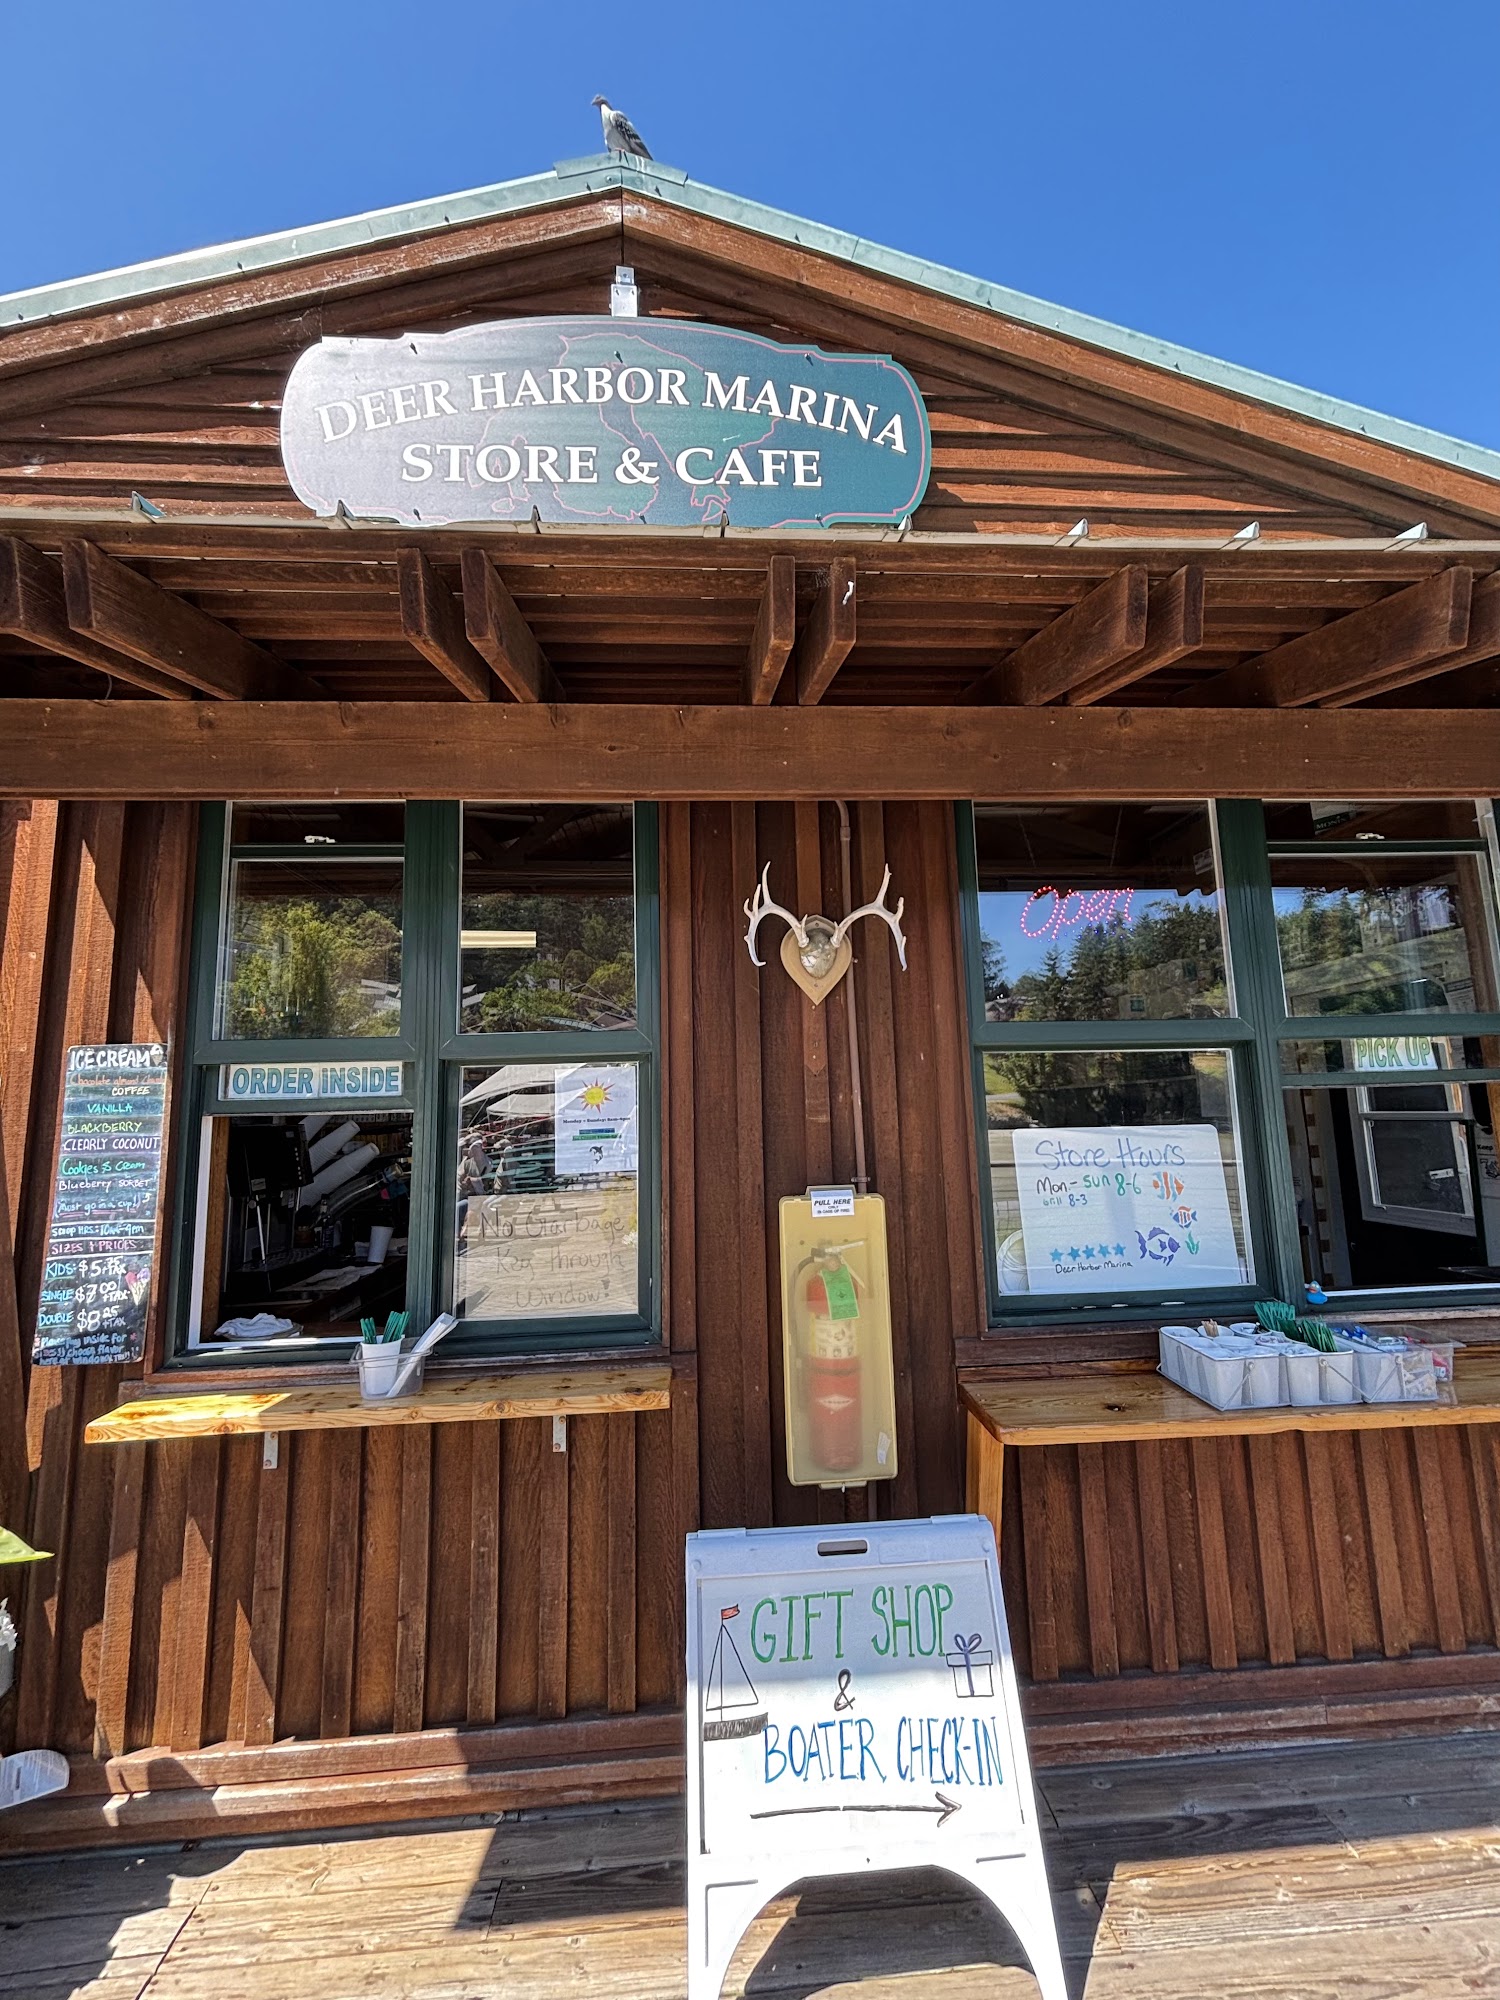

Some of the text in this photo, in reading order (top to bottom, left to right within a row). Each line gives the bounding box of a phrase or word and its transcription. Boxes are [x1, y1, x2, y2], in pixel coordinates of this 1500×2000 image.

[314, 366, 908, 454] DEER HARBOR MARINA
[401, 444, 822, 487] STORE & CAFE
[69, 1048, 150, 1070] ICE CREAM
[1356, 1036, 1431, 1067] PICK UP
[232, 1067, 314, 1094] ORDER
[112, 1086, 151, 1096] COFFEE
[87, 1103, 133, 1113] VANILLA
[67, 1121, 142, 1134] BLACKBERRY
[63, 1137, 161, 1151] CLEARLY COCONUT
[1035, 1138, 1186, 1170] Store Hours
[62, 1158, 98, 1178] Cookies
[59, 1179, 150, 1193] Blueberry SORBET
[84, 1202, 96, 1216] go
[1068, 1193, 1088, 1207] 8-3
[480, 1208, 625, 1247] No Garbage
[51, 1243, 84, 1255] SIZES
[98, 1240, 137, 1252] PRICES
[551, 1246, 626, 1278] through
[1055, 1260, 1133, 1274] Deer Harbor Marina
[41, 1289, 75, 1301] SINGLE
[39, 1311, 75, 1327] DOUBLE
[751, 1582, 954, 1663] GIFT SHOP
[834, 1668, 856, 1712] &
[763, 1716, 1003, 1786] BOATER CHECK-IN
